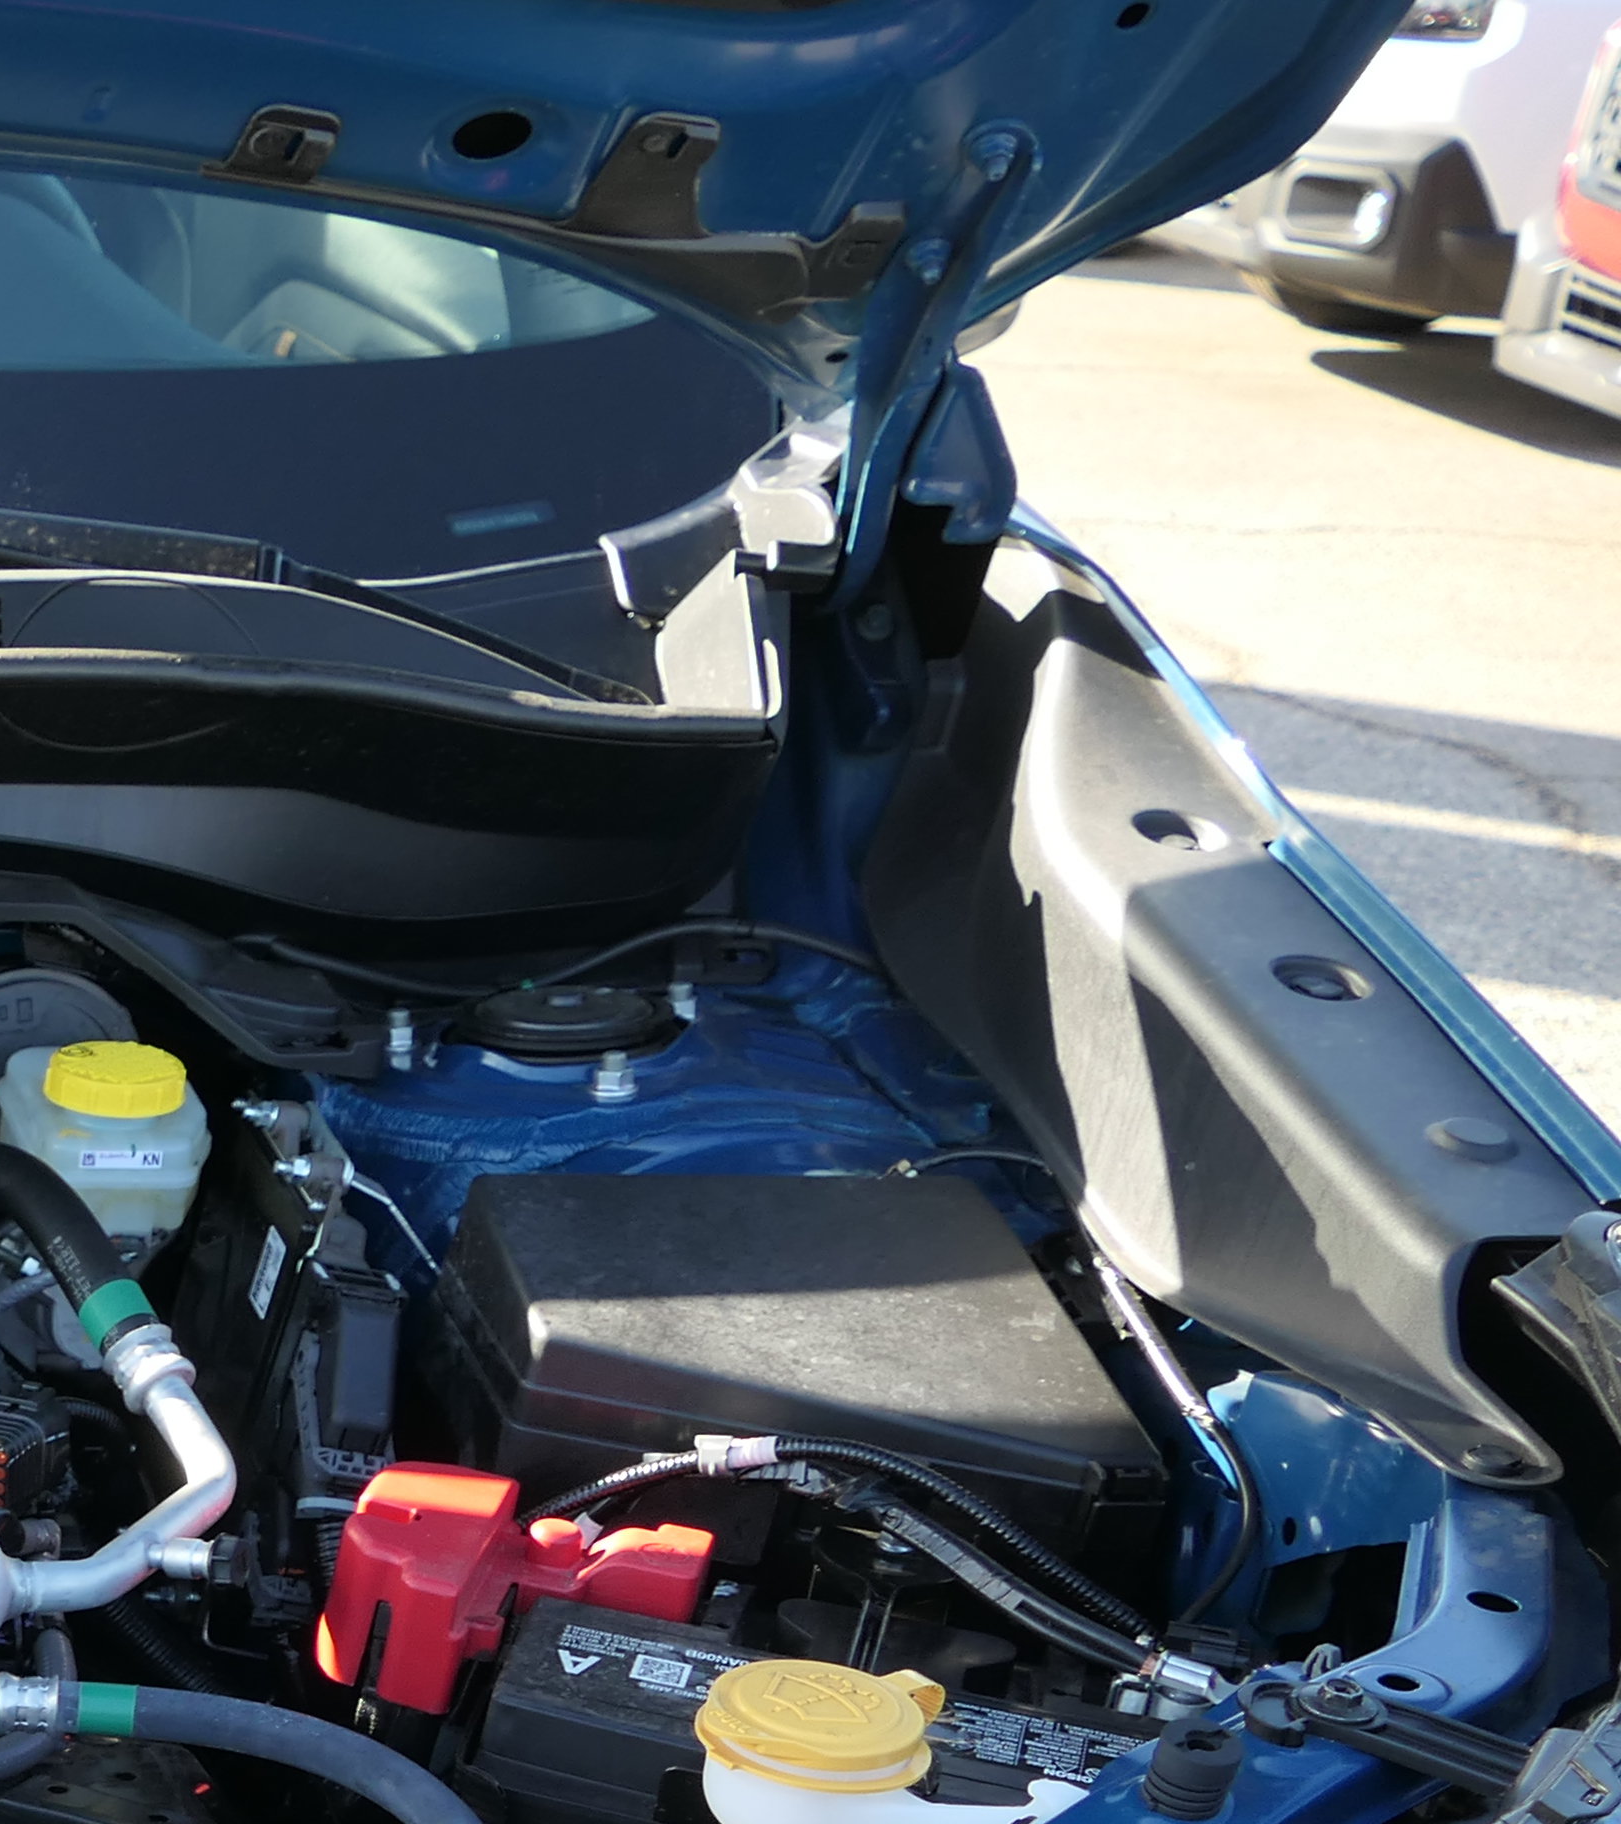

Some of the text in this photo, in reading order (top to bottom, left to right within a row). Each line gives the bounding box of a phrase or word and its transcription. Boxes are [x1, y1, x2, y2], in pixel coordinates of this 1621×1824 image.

[142, 1153, 161, 1167] KN
[557, 1649, 602, 1676] A
[685, 1648, 752, 1668] 0AN00B
[708, 1709, 750, 1735] PULL
[1043, 1767, 1094, 1785] OISON
